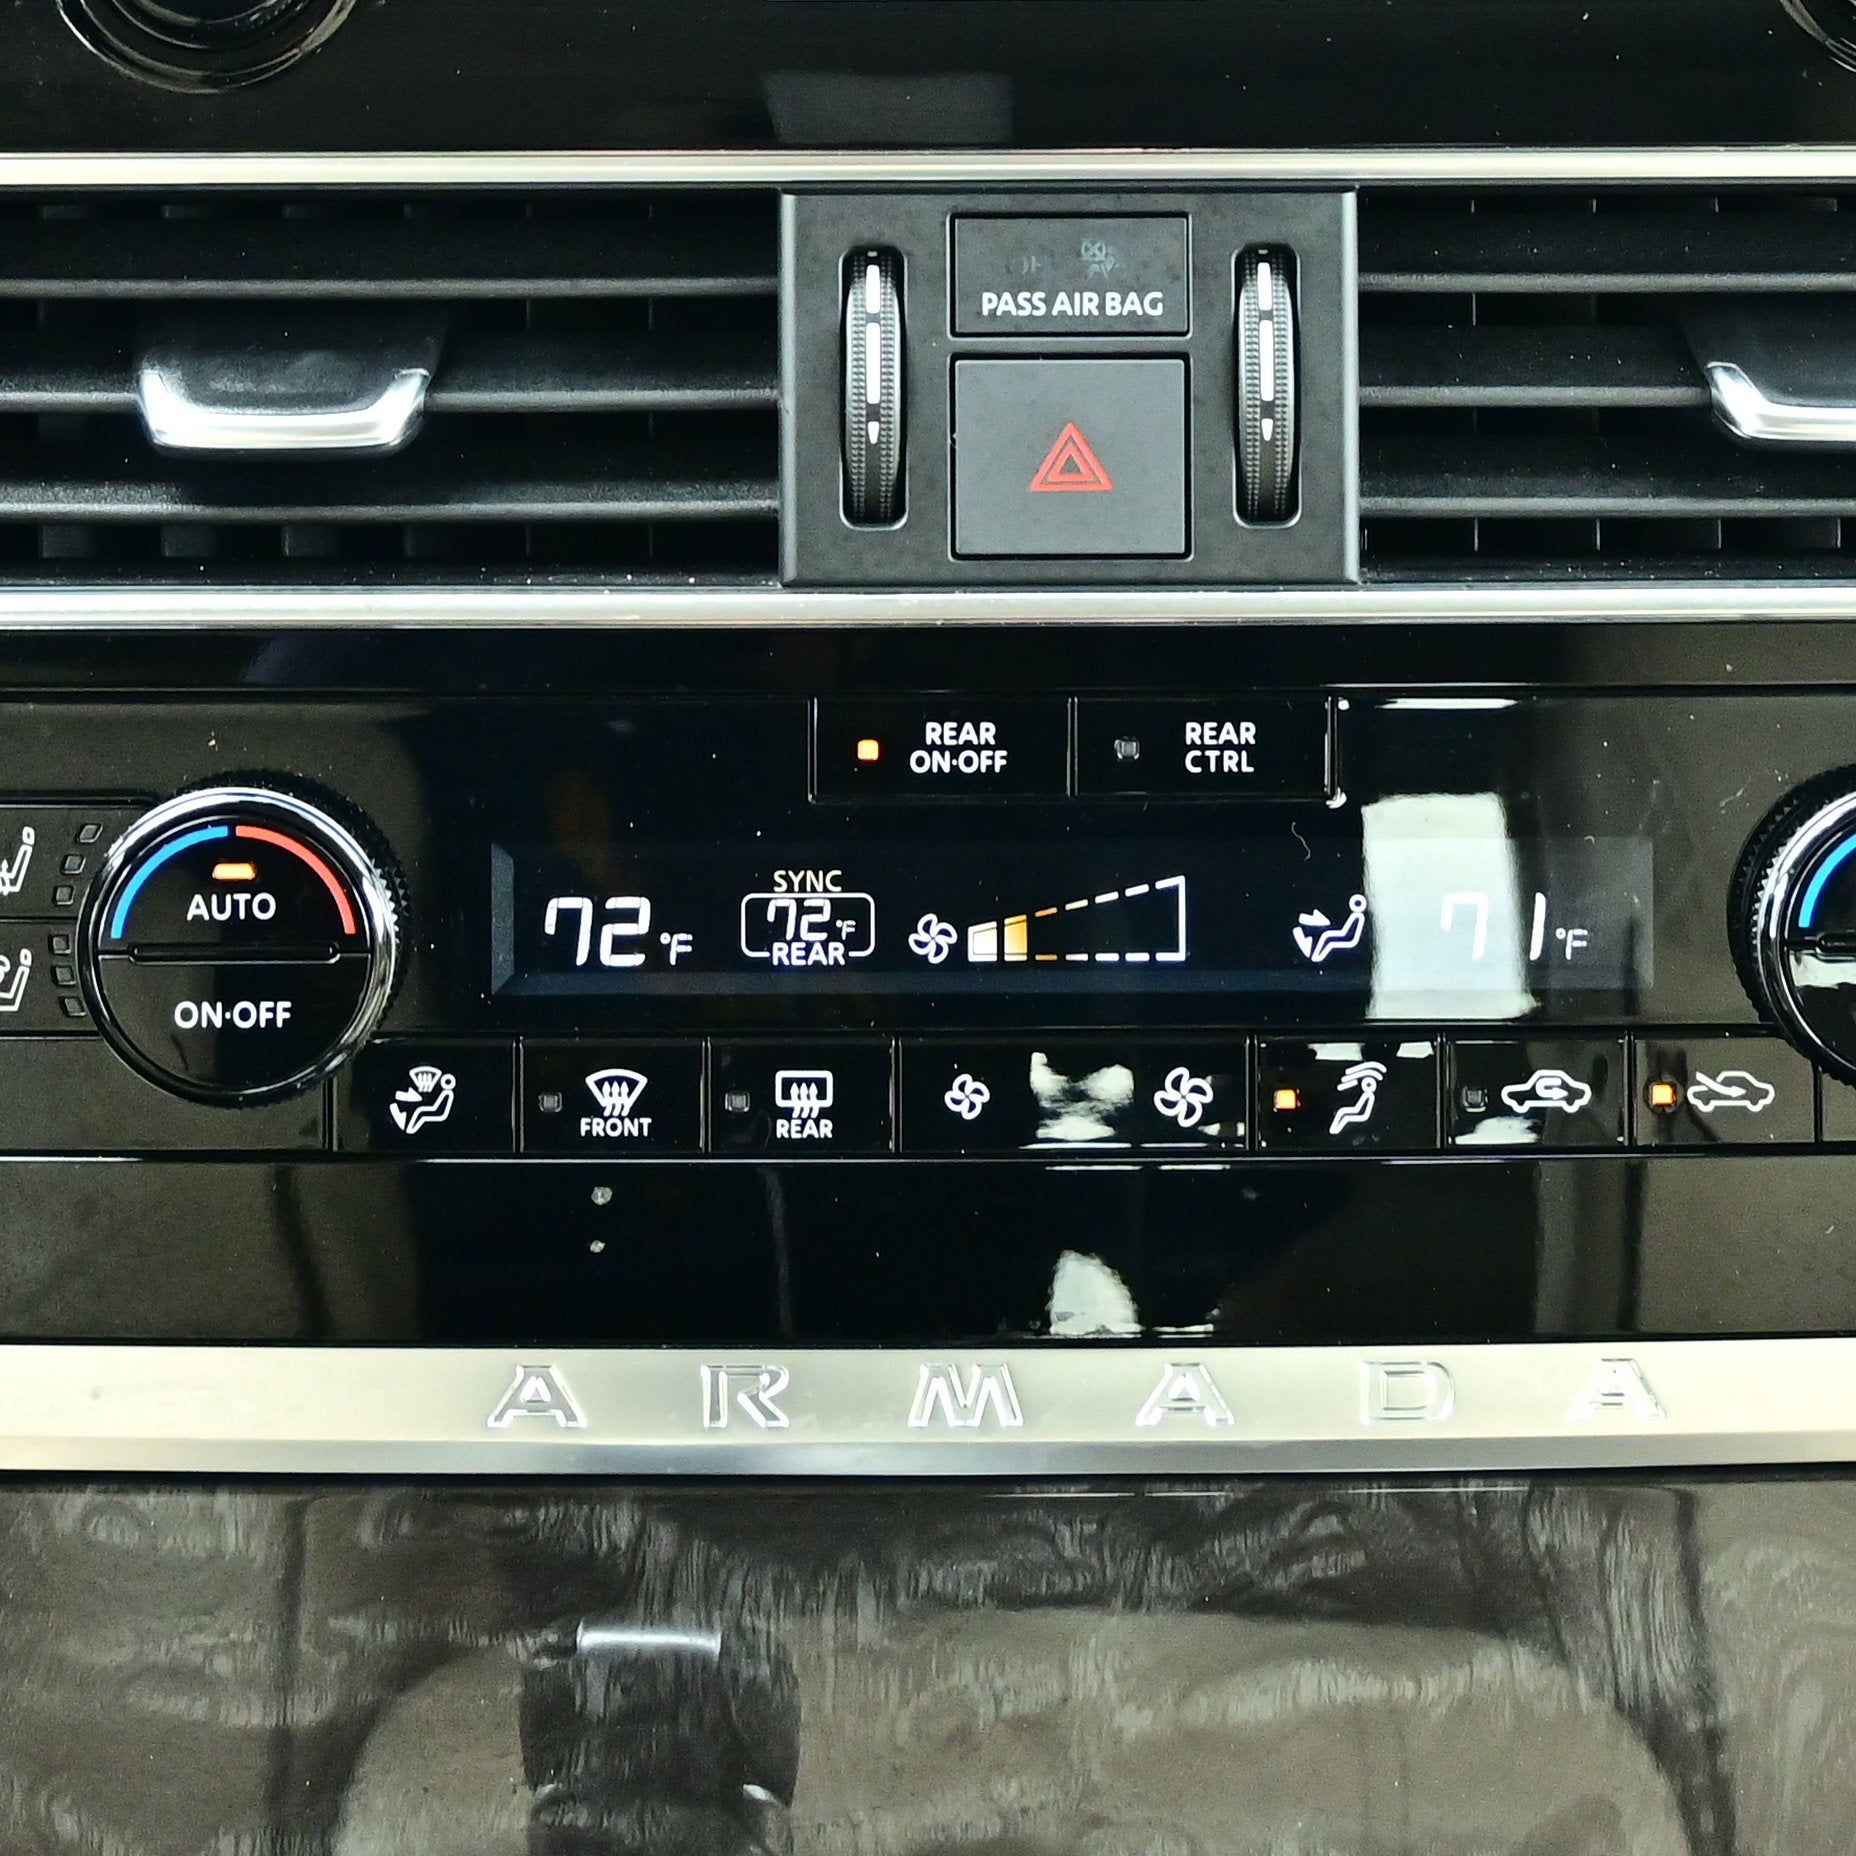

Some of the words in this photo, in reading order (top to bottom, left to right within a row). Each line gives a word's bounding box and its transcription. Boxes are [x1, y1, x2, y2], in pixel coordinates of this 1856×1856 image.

[980, 291, 1046, 318] PASS
[1051, 291, 1101, 317] AIR
[1104, 291, 1165, 317] BAG
[924, 722, 996, 745] REAR
[1184, 721, 1257, 745] REAR
[1184, 749, 1255, 774] CTRL
[773, 869, 842, 893] SYNC
[186, 892, 277, 921] AUTO
[772, 942, 846, 966] REAR
[579, 1116, 652, 1139] FRONT
[775, 1118, 834, 1140] REAR
[485, 1357, 1669, 1429] ARMADA
